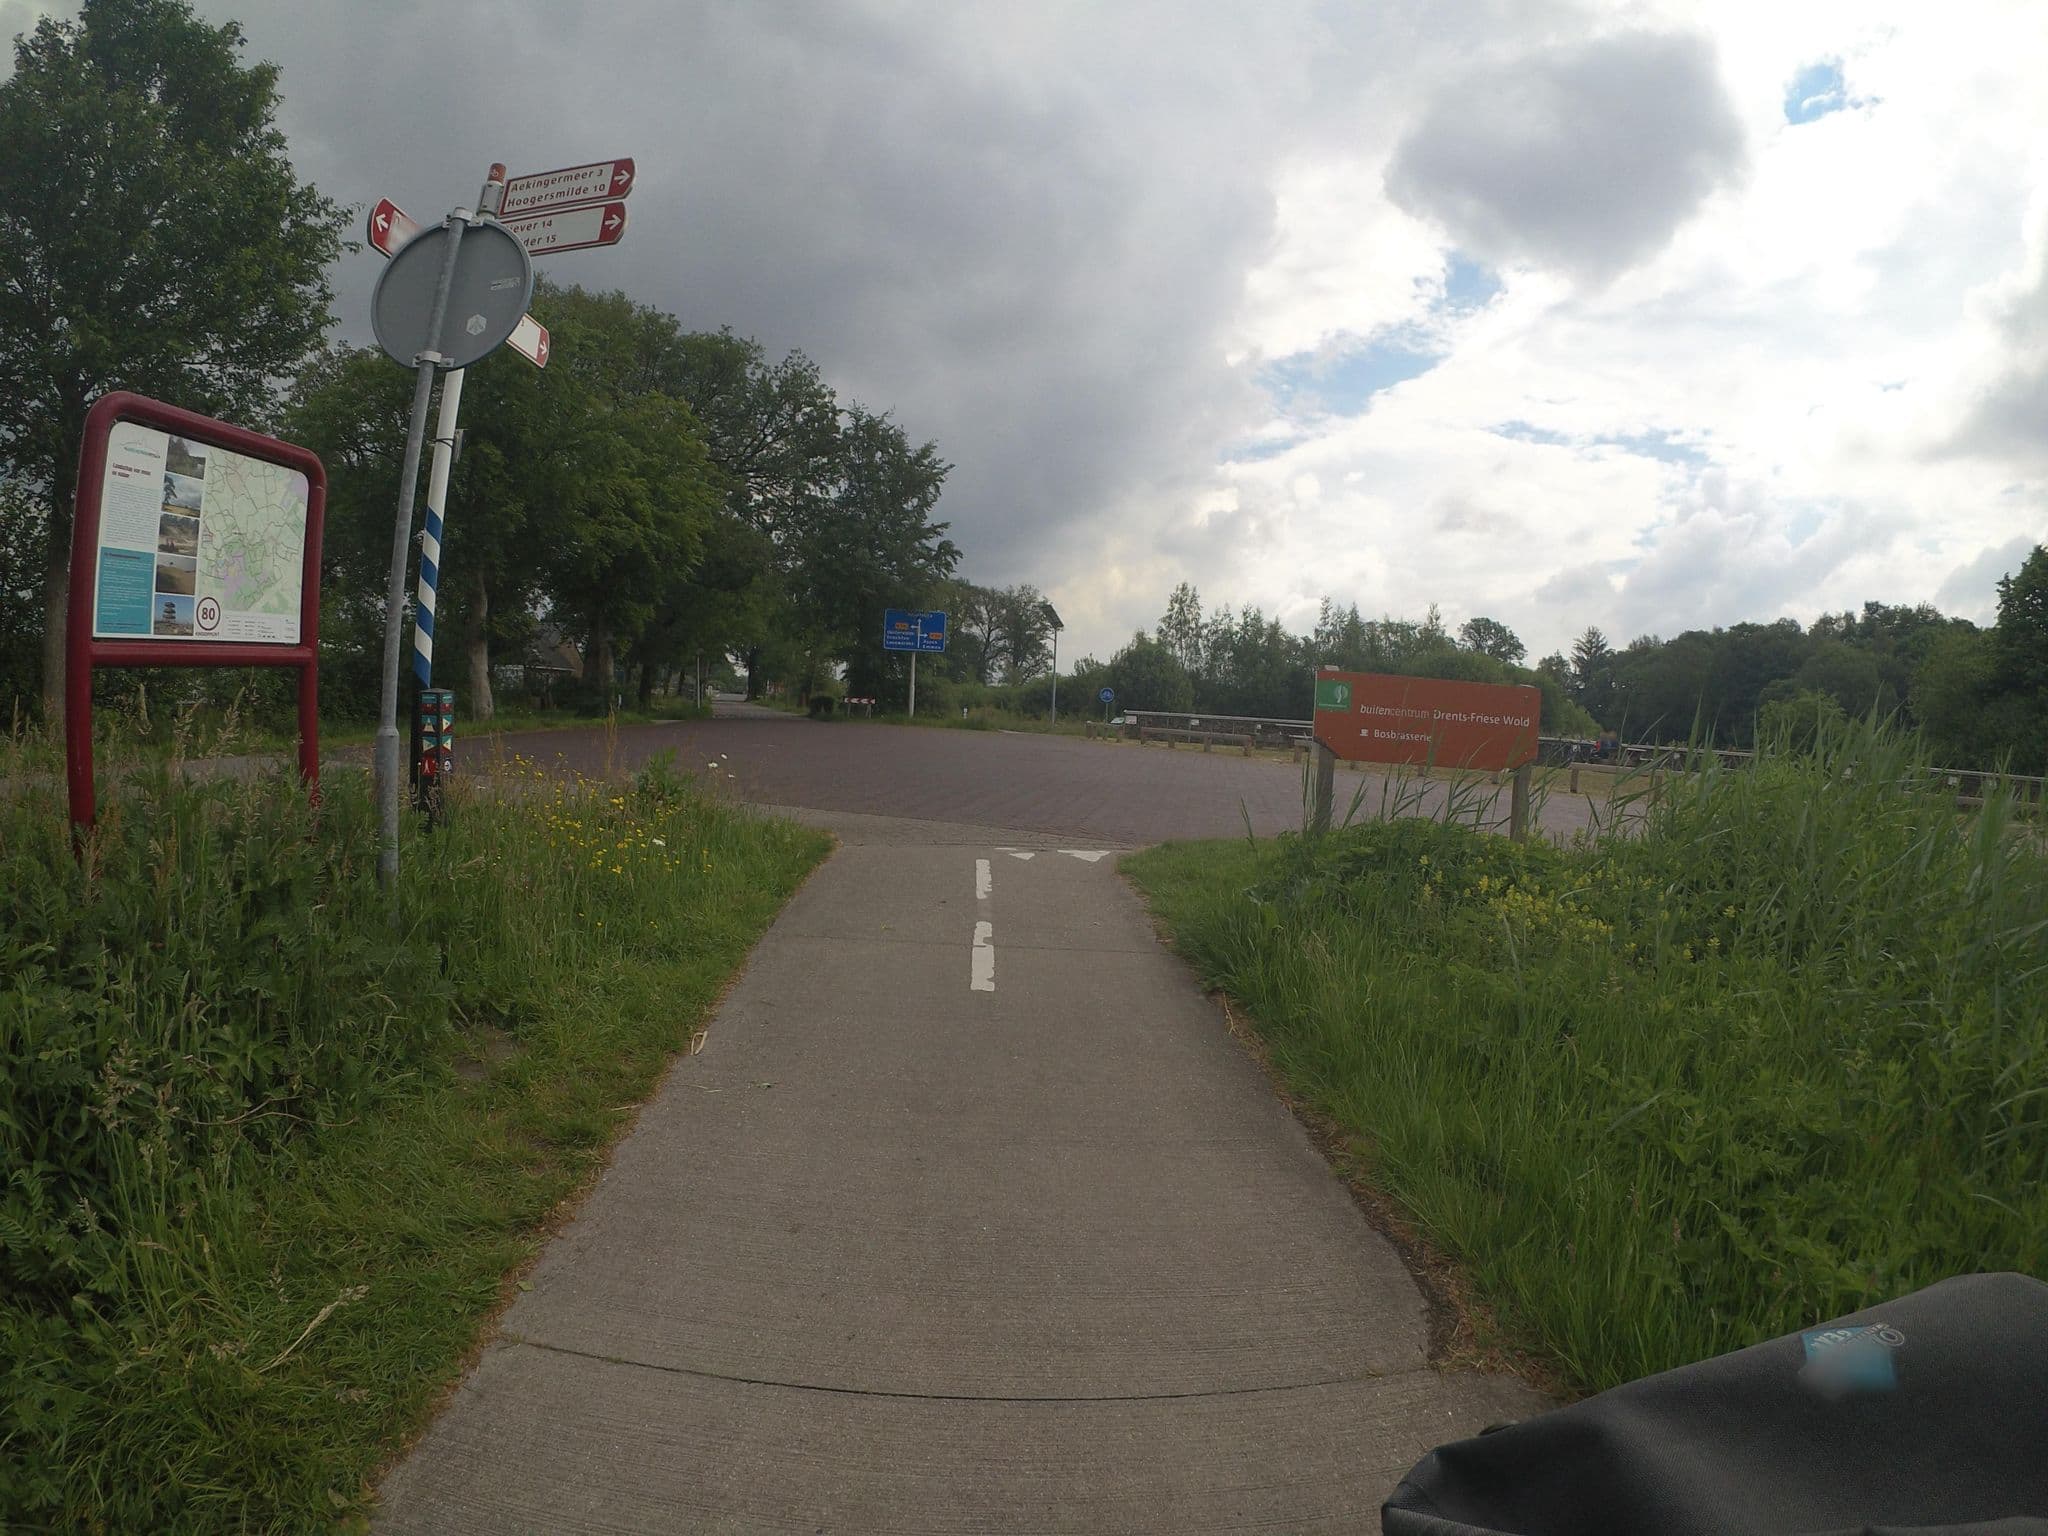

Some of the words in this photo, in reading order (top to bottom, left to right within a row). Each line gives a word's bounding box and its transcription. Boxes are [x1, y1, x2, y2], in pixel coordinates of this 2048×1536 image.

[511, 170, 594, 192] Aekingermeer
[596, 169, 603, 177] 3
[507, 185, 589, 207] Hoogersmilde
[594, 183, 606, 192] 10
[543, 220, 552, 228] 14
[546, 235, 556, 243] 15
[201, 607, 215, 620] 80
[1360, 704, 1430, 720] buitencentrum
[1433, 710, 1500, 726] Drents-Friese
[1503, 715, 1530, 728] Wold
